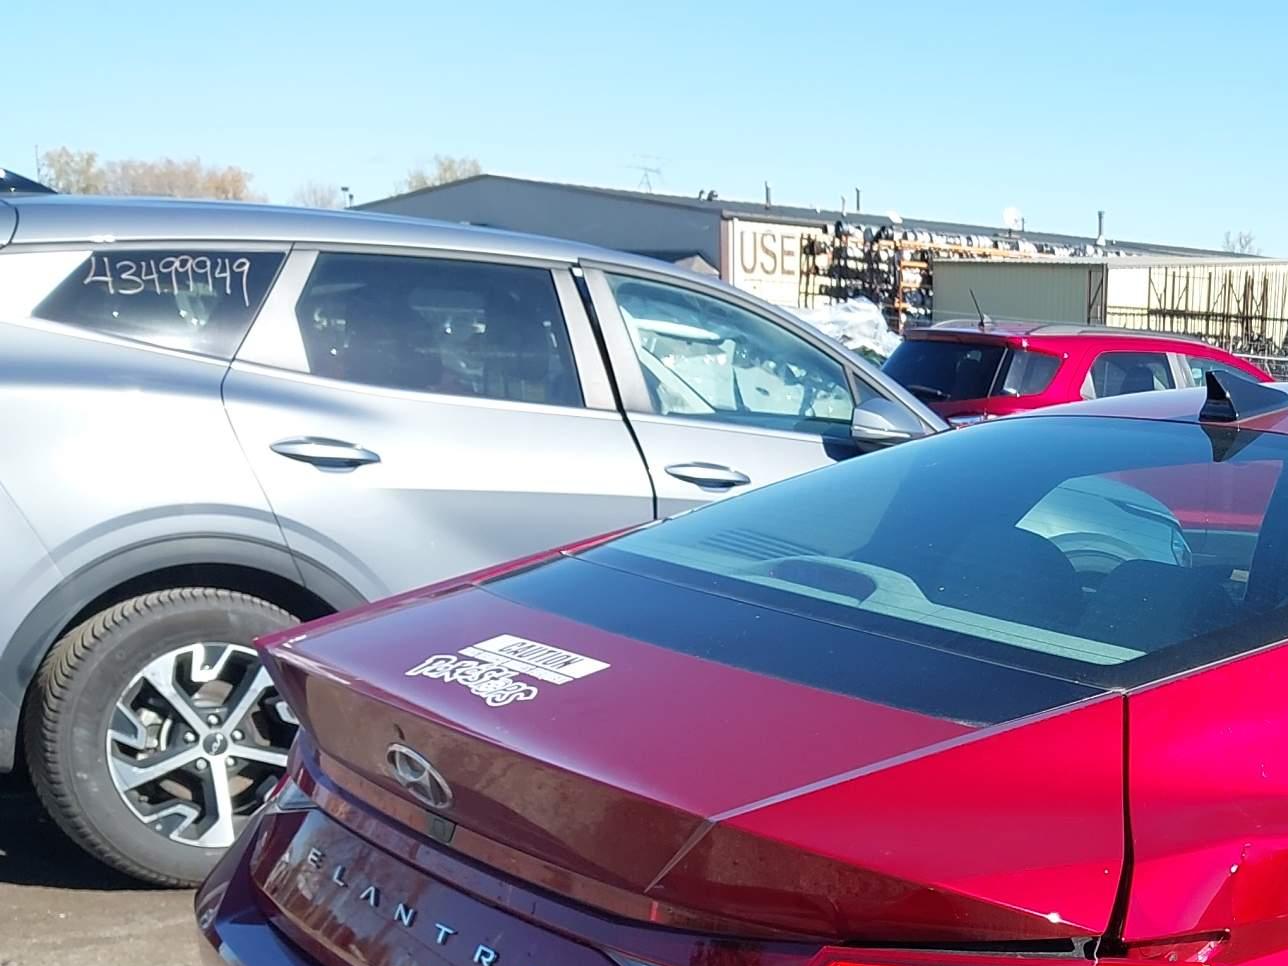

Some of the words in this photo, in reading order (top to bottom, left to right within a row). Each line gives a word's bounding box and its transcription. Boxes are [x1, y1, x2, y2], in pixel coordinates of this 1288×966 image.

[740, 230, 814, 277] USE
[83, 256, 251, 307] 43499949
[499, 641, 584, 670] CAUTION
